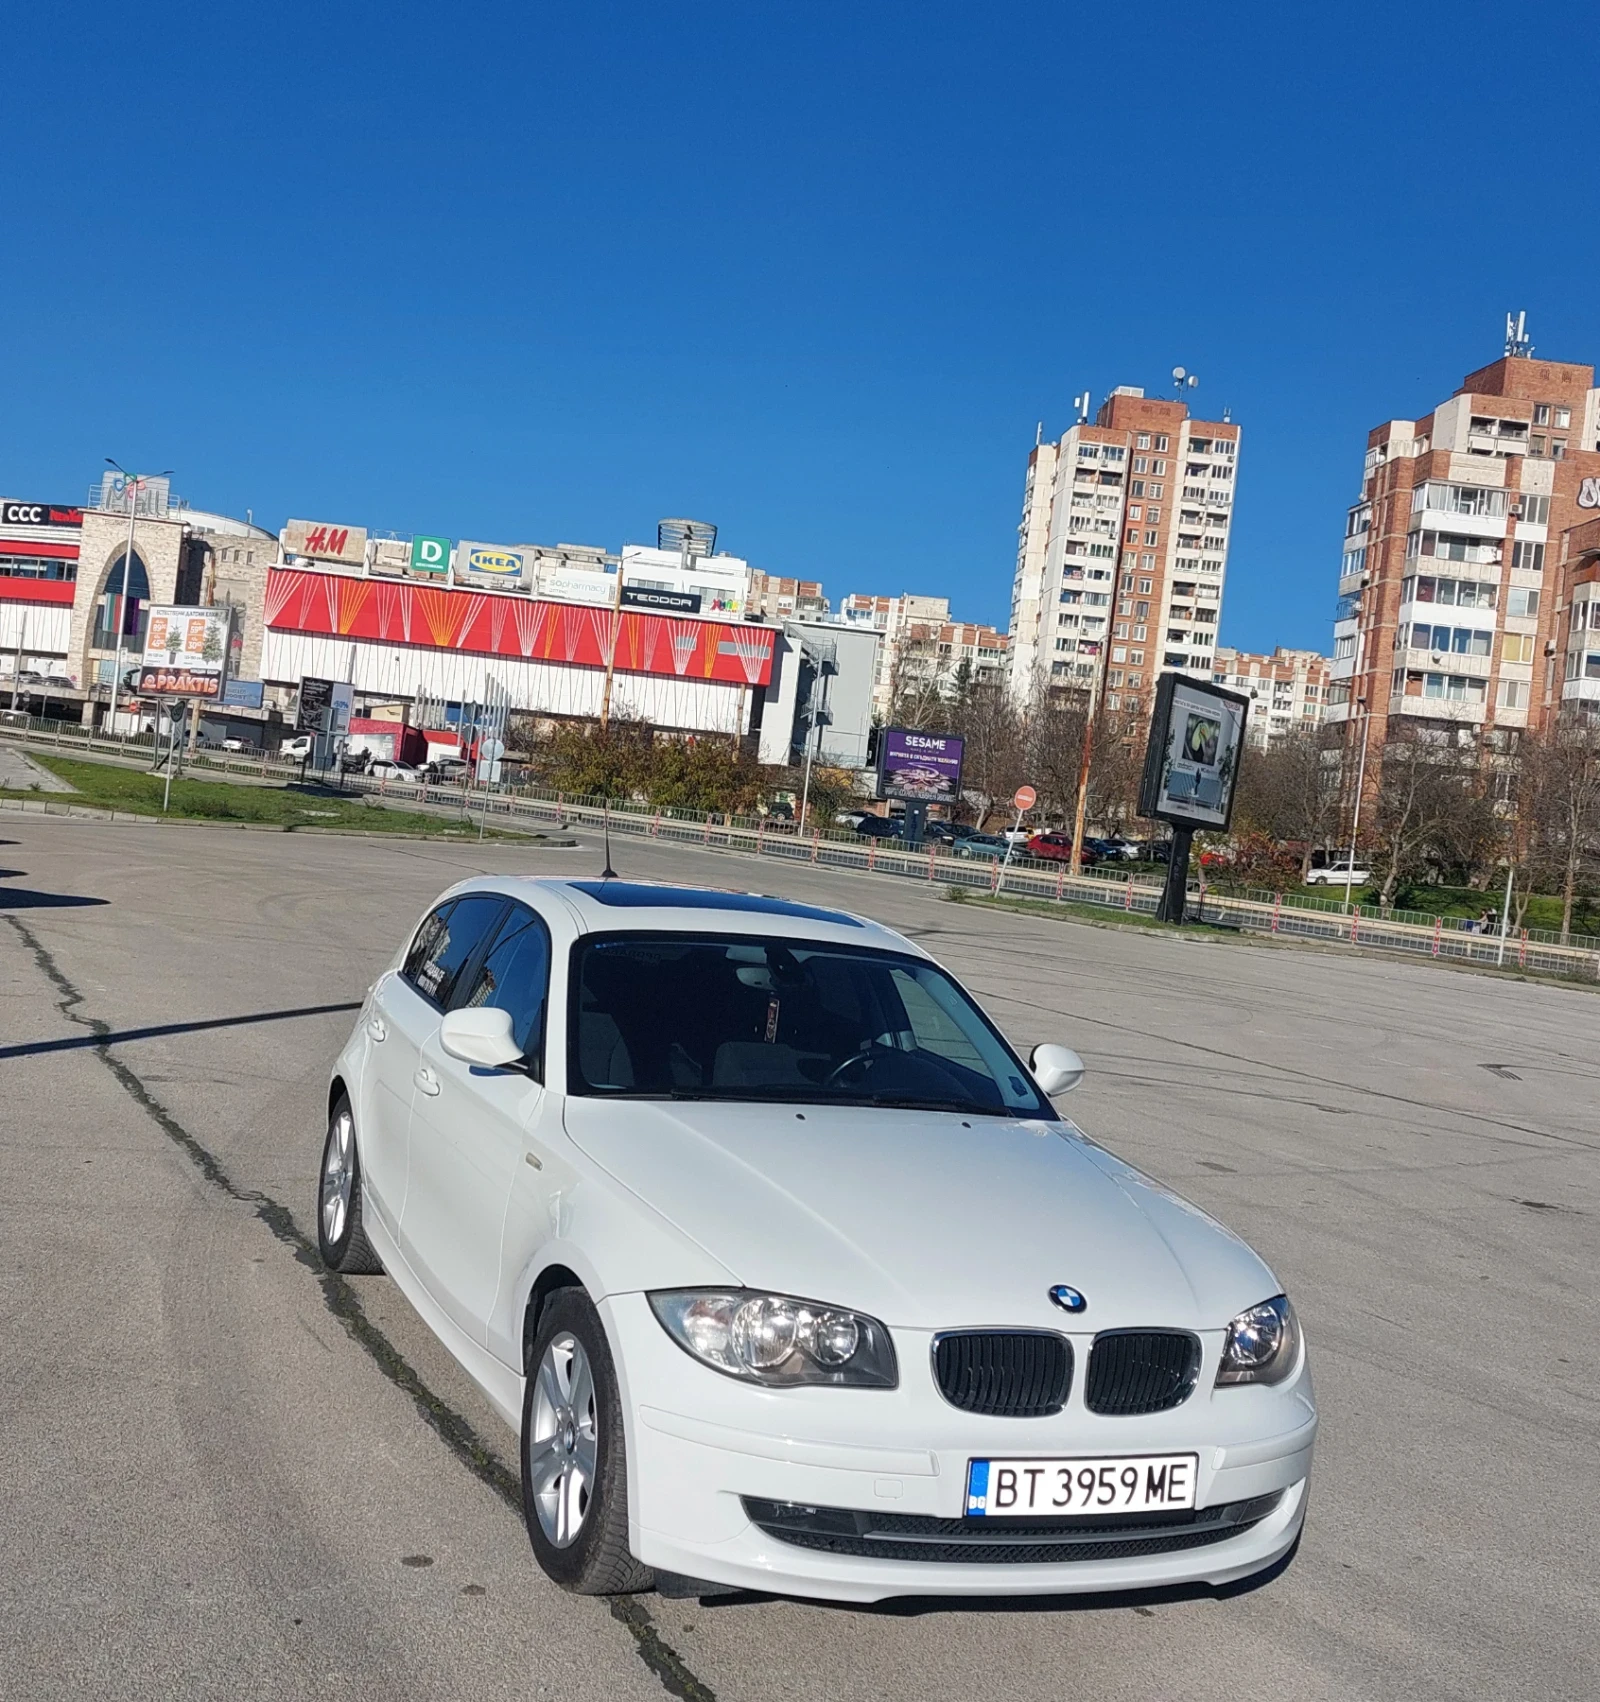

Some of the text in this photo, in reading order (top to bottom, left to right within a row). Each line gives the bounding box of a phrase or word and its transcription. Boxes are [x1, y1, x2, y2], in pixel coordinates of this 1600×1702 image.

[8, 505, 42, 522] CCC
[305, 527, 349, 556] H&M
[421, 541, 443, 562] D
[475, 556, 516, 568] IKEA
[549, 579, 606, 594] sopharmacy
[627, 592, 692, 607] TEODOR
[157, 674, 219, 694] PRAKTIS
[905, 735, 946, 750] SESAME
[995, 1463, 1189, 1508] BT 3959 ME
[968, 1496, 986, 1510] BG
